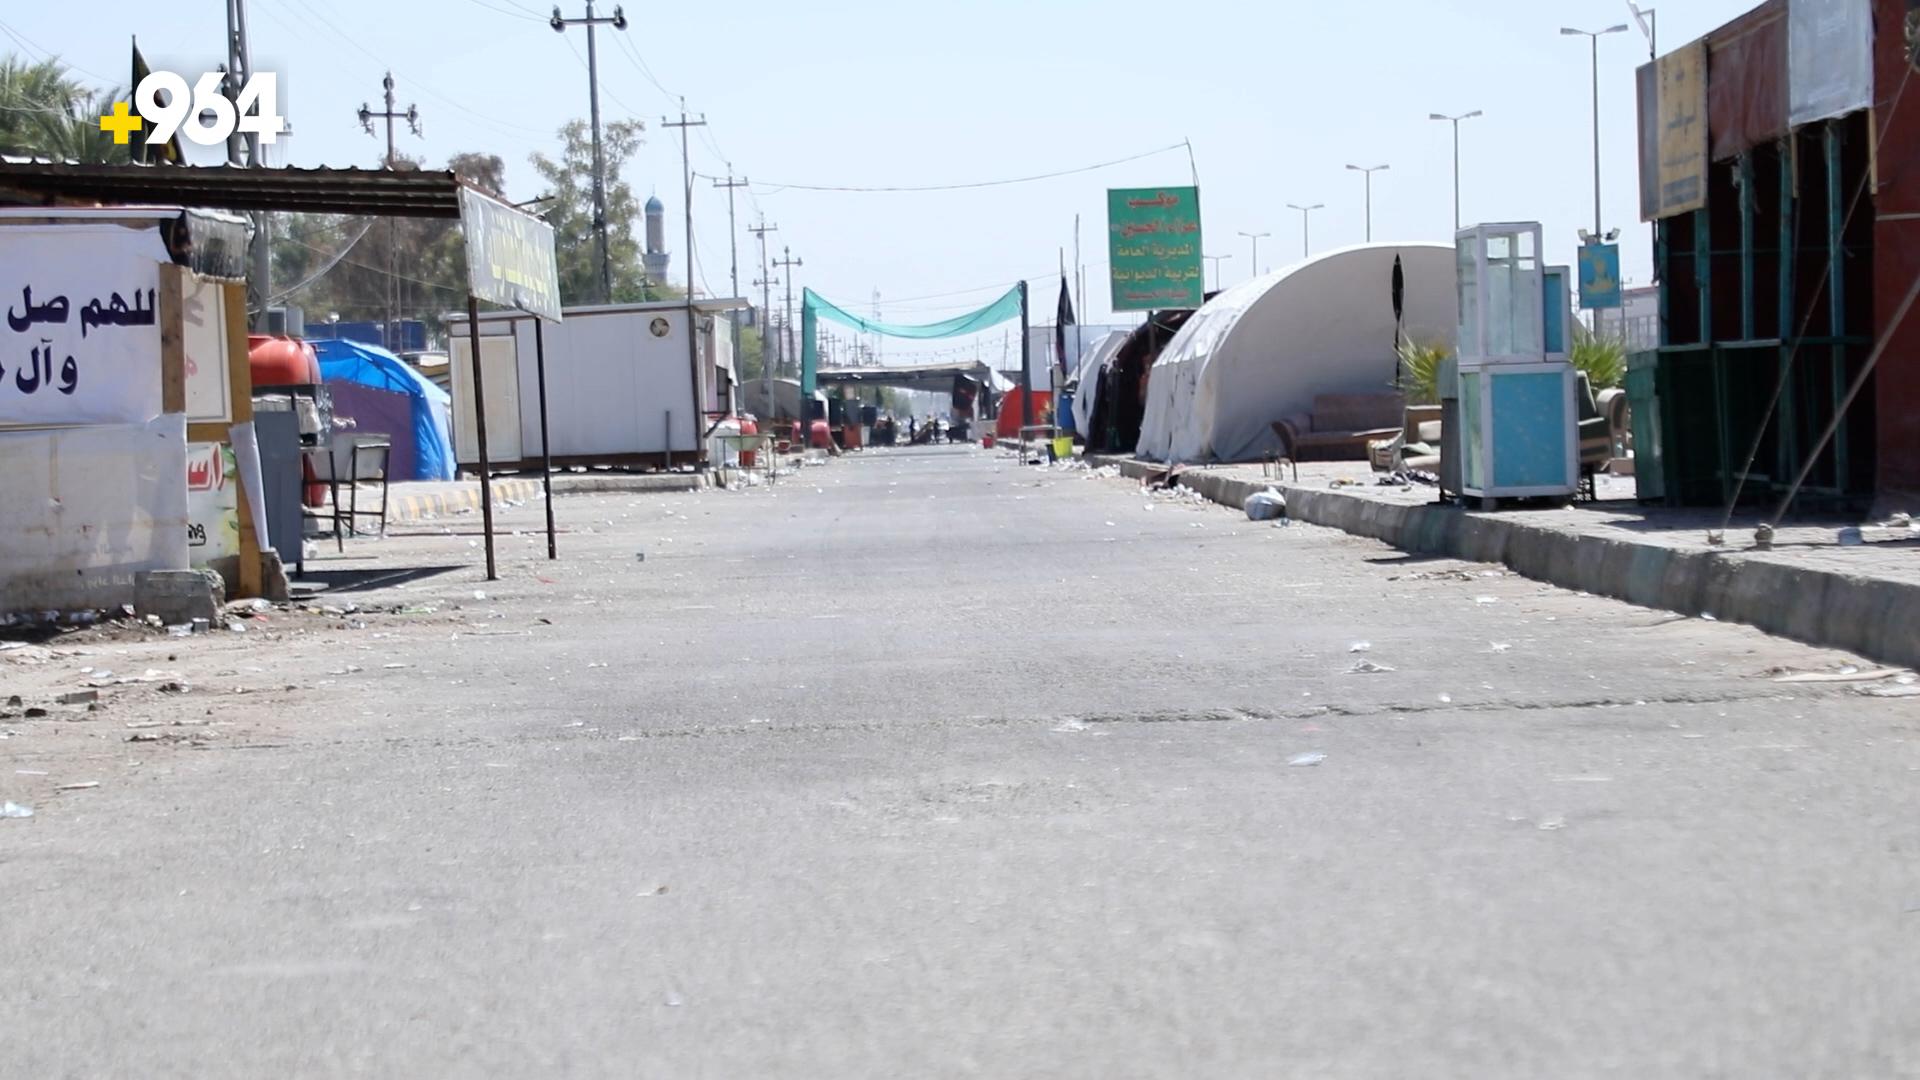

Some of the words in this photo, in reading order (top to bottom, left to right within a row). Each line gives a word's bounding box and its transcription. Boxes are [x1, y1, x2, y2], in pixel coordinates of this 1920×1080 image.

[1117, 244, 1150, 256] العامة
[1152, 243, 1193, 260] المديرية
[1112, 266, 1162, 283] الديوانية
[1165, 264, 1199, 282] لتربية
[8, 284, 70, 333] صل
